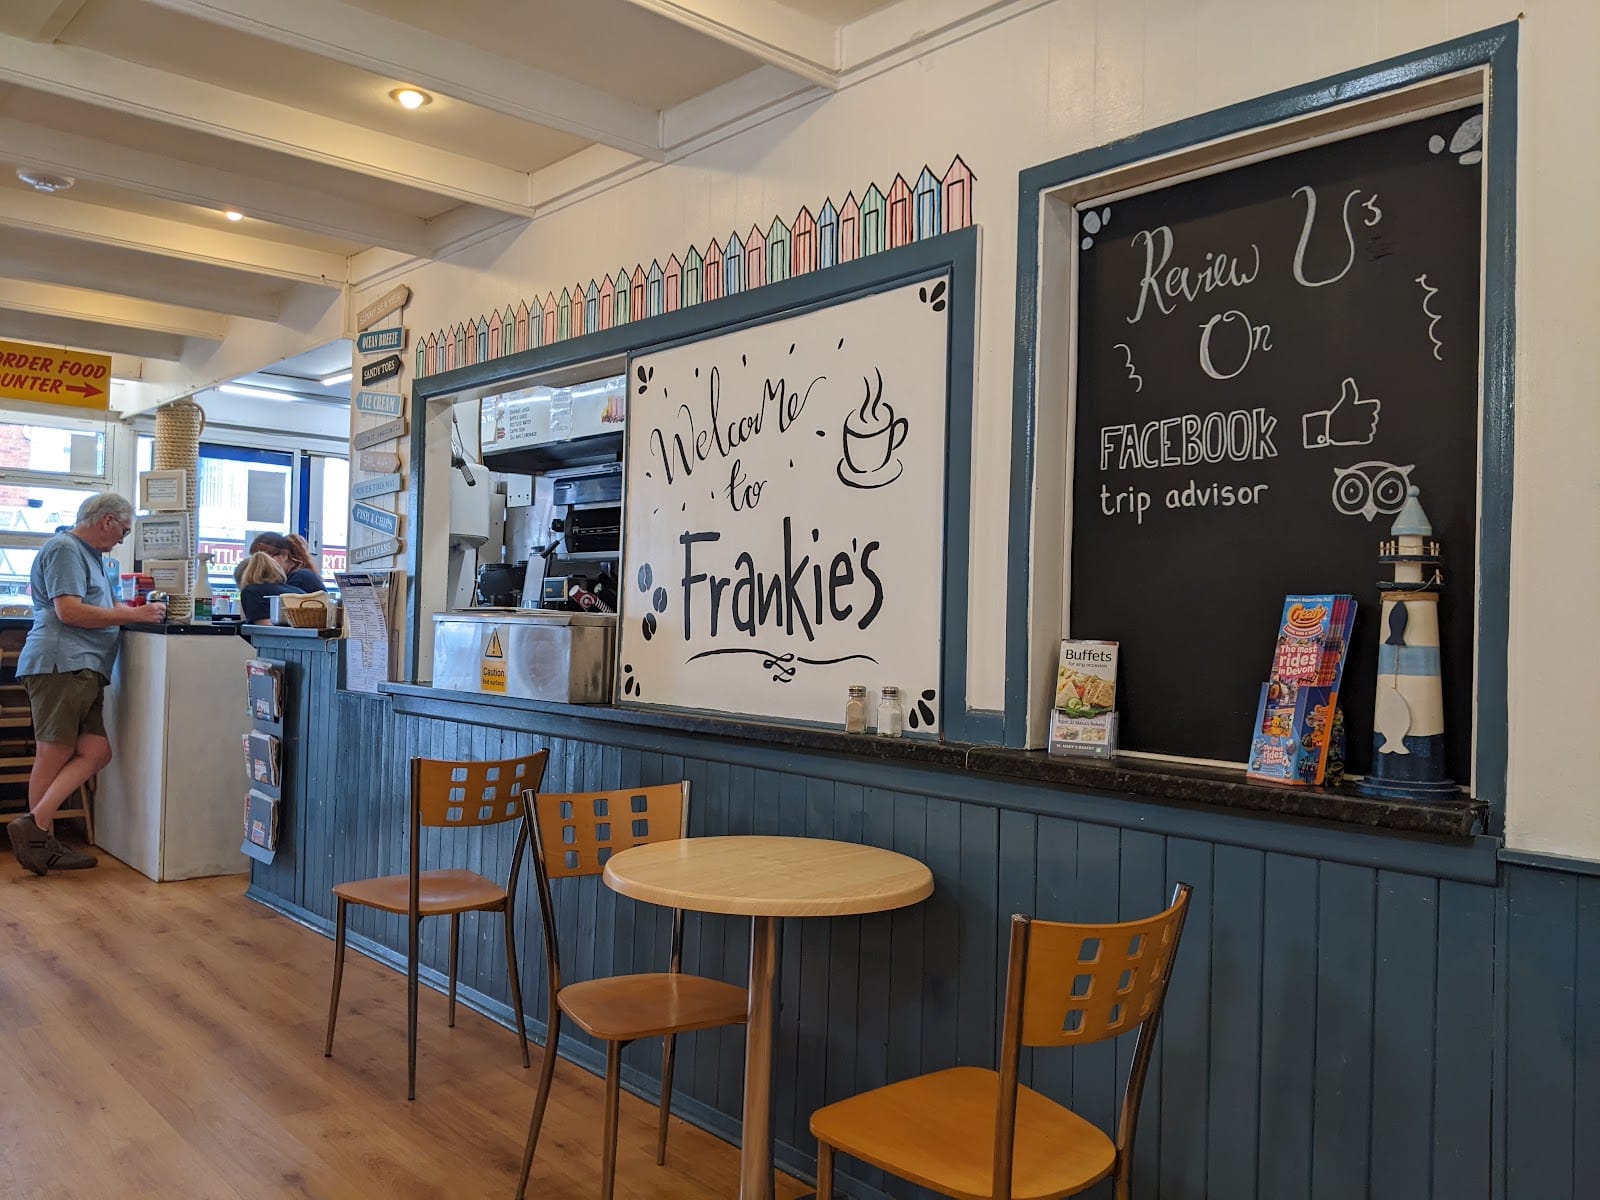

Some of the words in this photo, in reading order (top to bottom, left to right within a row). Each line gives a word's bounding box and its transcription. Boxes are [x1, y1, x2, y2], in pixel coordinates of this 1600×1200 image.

[1126, 225, 1261, 324] Review
[1291, 185, 1383, 287] Us
[362, 335, 378, 349] OCEAN
[378, 332, 398, 347] BREEZE
[1199, 310, 1272, 380] On
[57, 360, 107, 379] FOOD
[363, 366, 381, 379] SANDY
[381, 360, 395, 373] TOES
[0, 373, 63, 394] UNTER
[361, 397, 372, 409] ICE
[373, 397, 395, 411] CREAM
[1100, 407, 1279, 470] FACEBOOK
[726, 459, 768, 511] to
[1100, 484, 1151, 524] trip
[1165, 480, 1269, 509] advisor
[356, 508, 370, 522] FISH
[370, 513, 375, 523] &
[374, 514, 393, 530] CHIPS
[355, 542, 391, 560] CAMPERVANS
[680, 516, 884, 642] Frankie's
[1065, 648, 1112, 662] Buffets
[1280, 645, 1296, 653] The
[1297, 643, 1317, 653] most
[1279, 653, 1317, 667] rides
[1286, 664, 1316, 675] Devon!
[483, 667, 504, 677] Caution
[1263, 750, 1283, 760] rides
